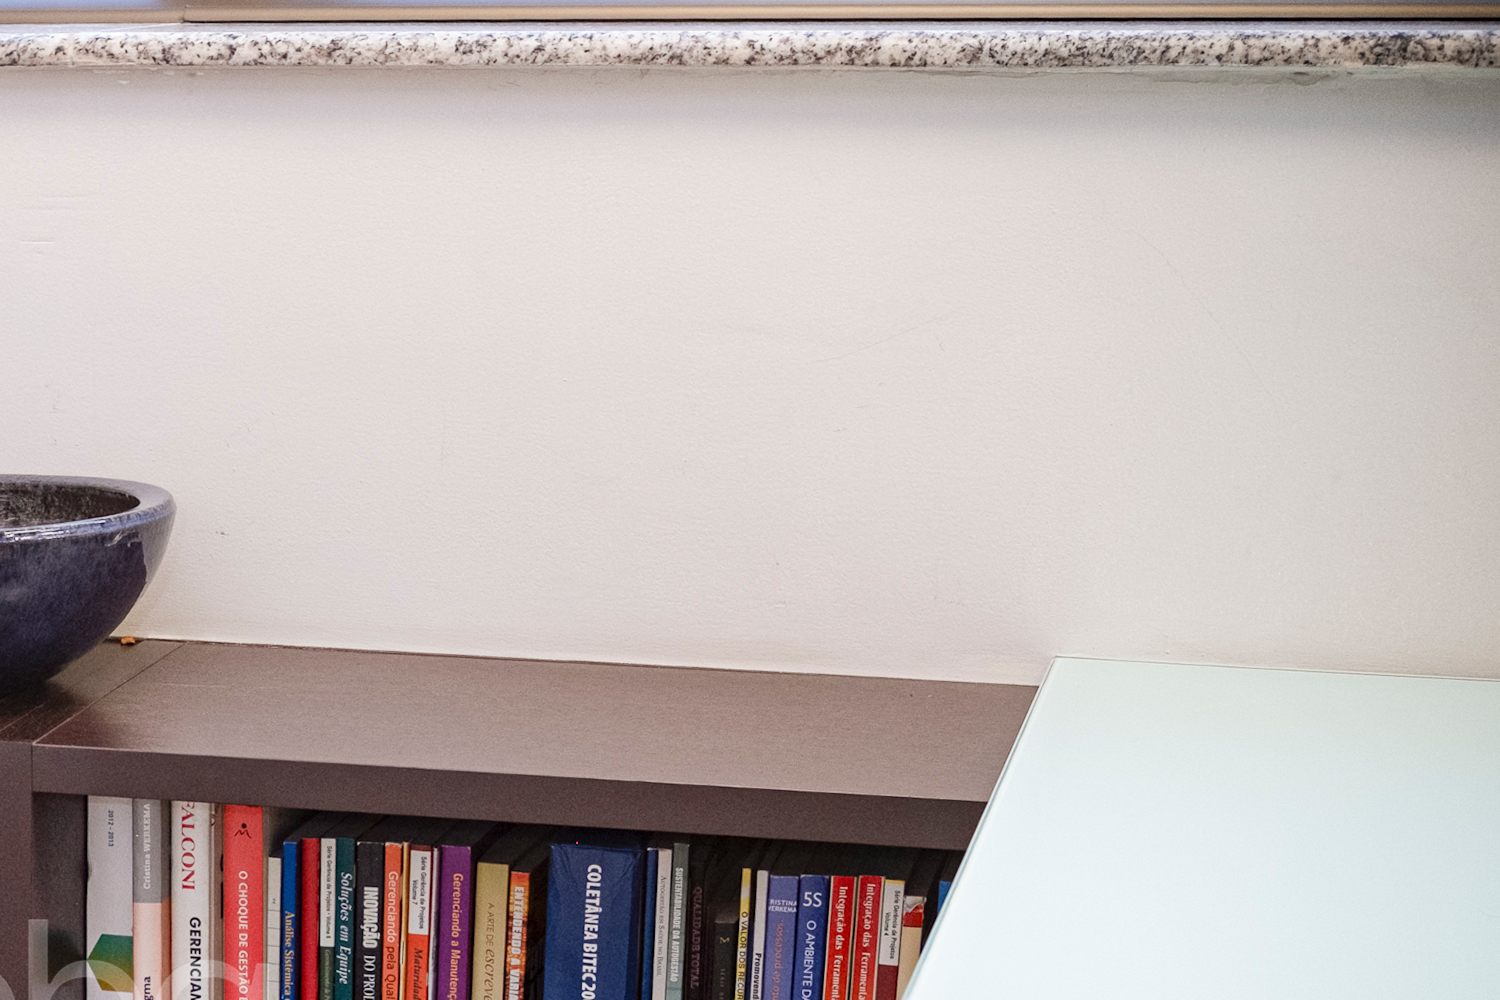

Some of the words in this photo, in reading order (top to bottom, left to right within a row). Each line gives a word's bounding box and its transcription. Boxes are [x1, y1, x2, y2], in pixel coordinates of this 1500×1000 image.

[142, 803, 151, 851] WERKEMA
[143, 853, 152, 888] Cristina
[238, 870, 247, 879] O
[237, 882, 247, 929] CHOQUE
[337, 872, 352, 921] Soluções
[359, 886, 382, 948] INOVAÇÃO
[387, 871, 398, 943] Gerenciando
[450, 873, 463, 937] Gerenciando
[584, 864, 603, 940] COLETÂNEA
[803, 891, 822, 908] 5S
[238, 933, 247, 946] DE
[284, 911, 294, 946] Análise
[339, 925, 348, 941] em
[510, 886, 524, 954] ENTENDENDO
[806, 920, 816, 930] O
[238, 950, 250, 993] GESTÃO
[284, 950, 293, 995] Sistêmica
[335, 945, 351, 984] Equipe
[363, 955, 375, 971] DO
[384, 947, 396, 971] pela
[581, 943, 597, 981] BITEC
[802, 933, 815, 985] AMBIENTE
